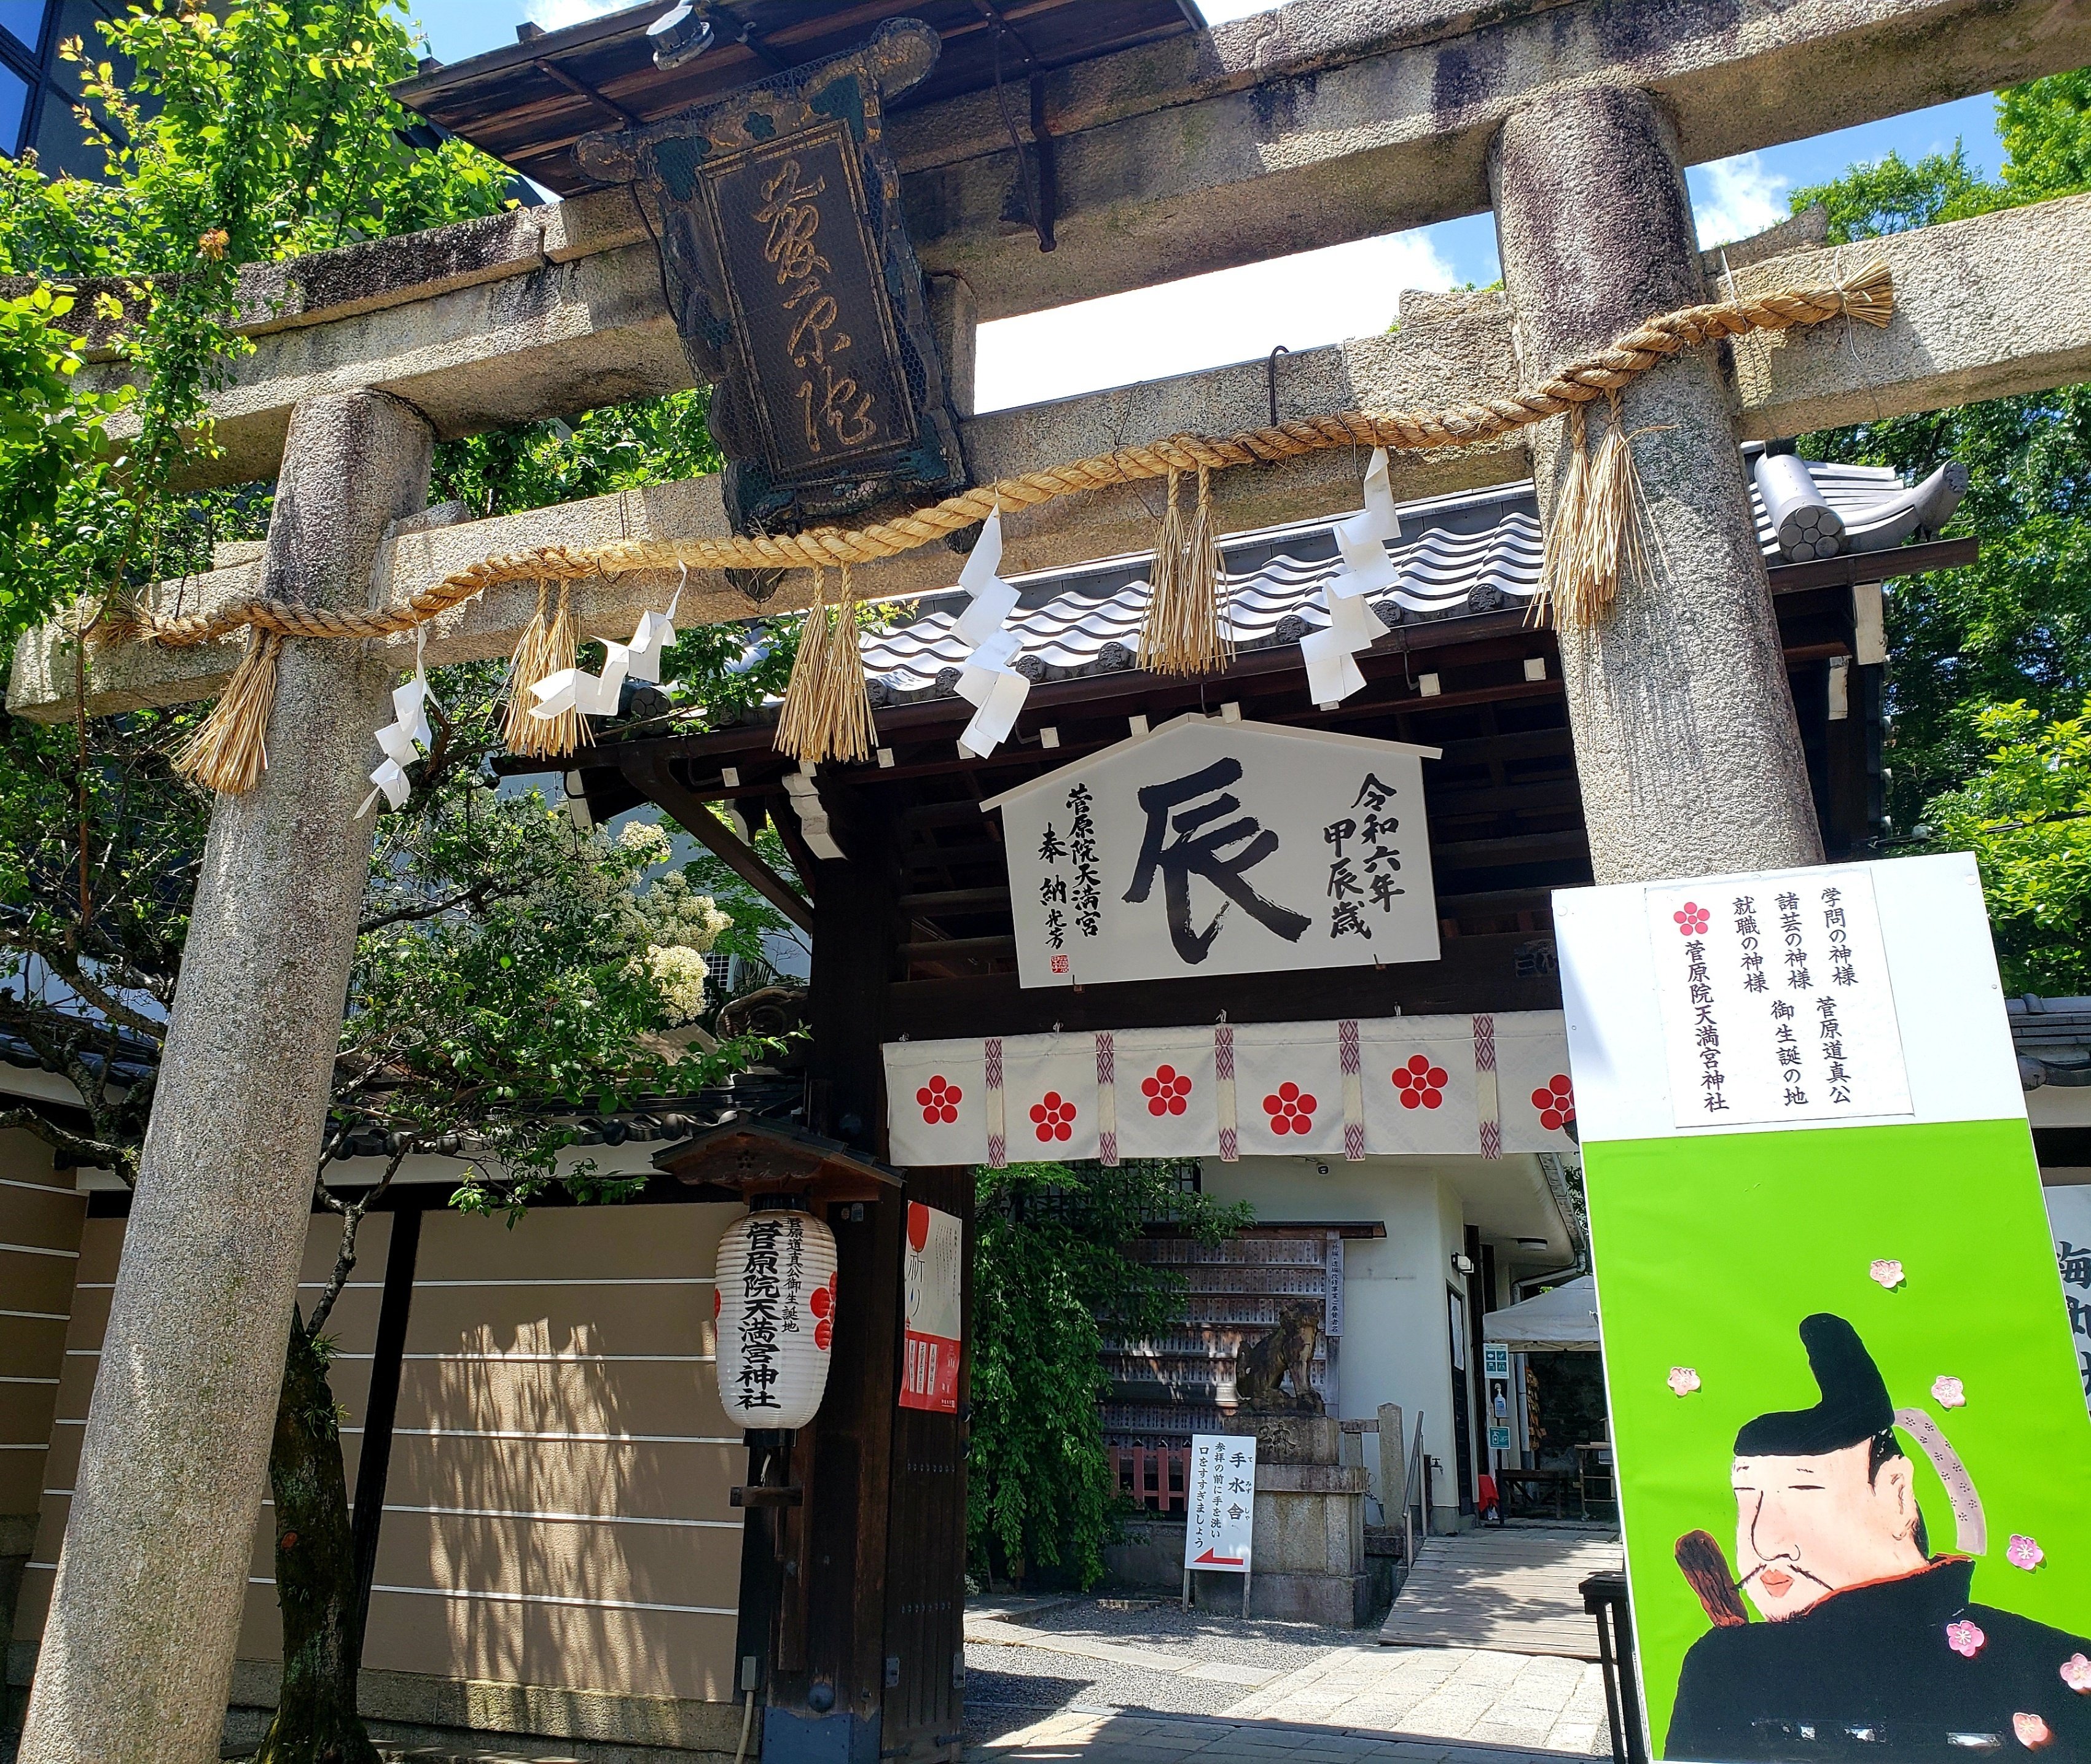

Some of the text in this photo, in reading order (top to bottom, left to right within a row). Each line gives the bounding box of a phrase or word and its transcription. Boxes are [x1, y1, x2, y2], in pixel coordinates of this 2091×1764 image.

[1038, 821, 1070, 907] 奉納
[1066, 782, 1101, 938] 菅原院天満宮
[1121, 757, 1312, 965] 辰
[1323, 818, 1372, 940] 甲辰歳
[1351, 772, 1405, 913] 令和六年
[1732, 896, 1769, 993] 就職の神様
[1774, 892, 1813, 990] 諸芸の神様
[1821, 888, 1859, 986] 学問の神様
[1684, 940, 1730, 1113] 菅原院天満宮神社
[1770, 999, 1809, 1106] 御生誕の地
[1816, 996, 1852, 1104] 菅原道真公
[735, 1219, 784, 1410] 菅原院天満宮神社
[781, 1217, 805, 1333] 菅原道真公御生誕地
[907, 1252, 925, 1317] 祈り
[1194, 1446, 1210, 1548] 口をすすぎましょう
[1210, 1442, 1226, 1538] 参拝の前に手を洗い
[1227, 1451, 1248, 1521] 手水舎
